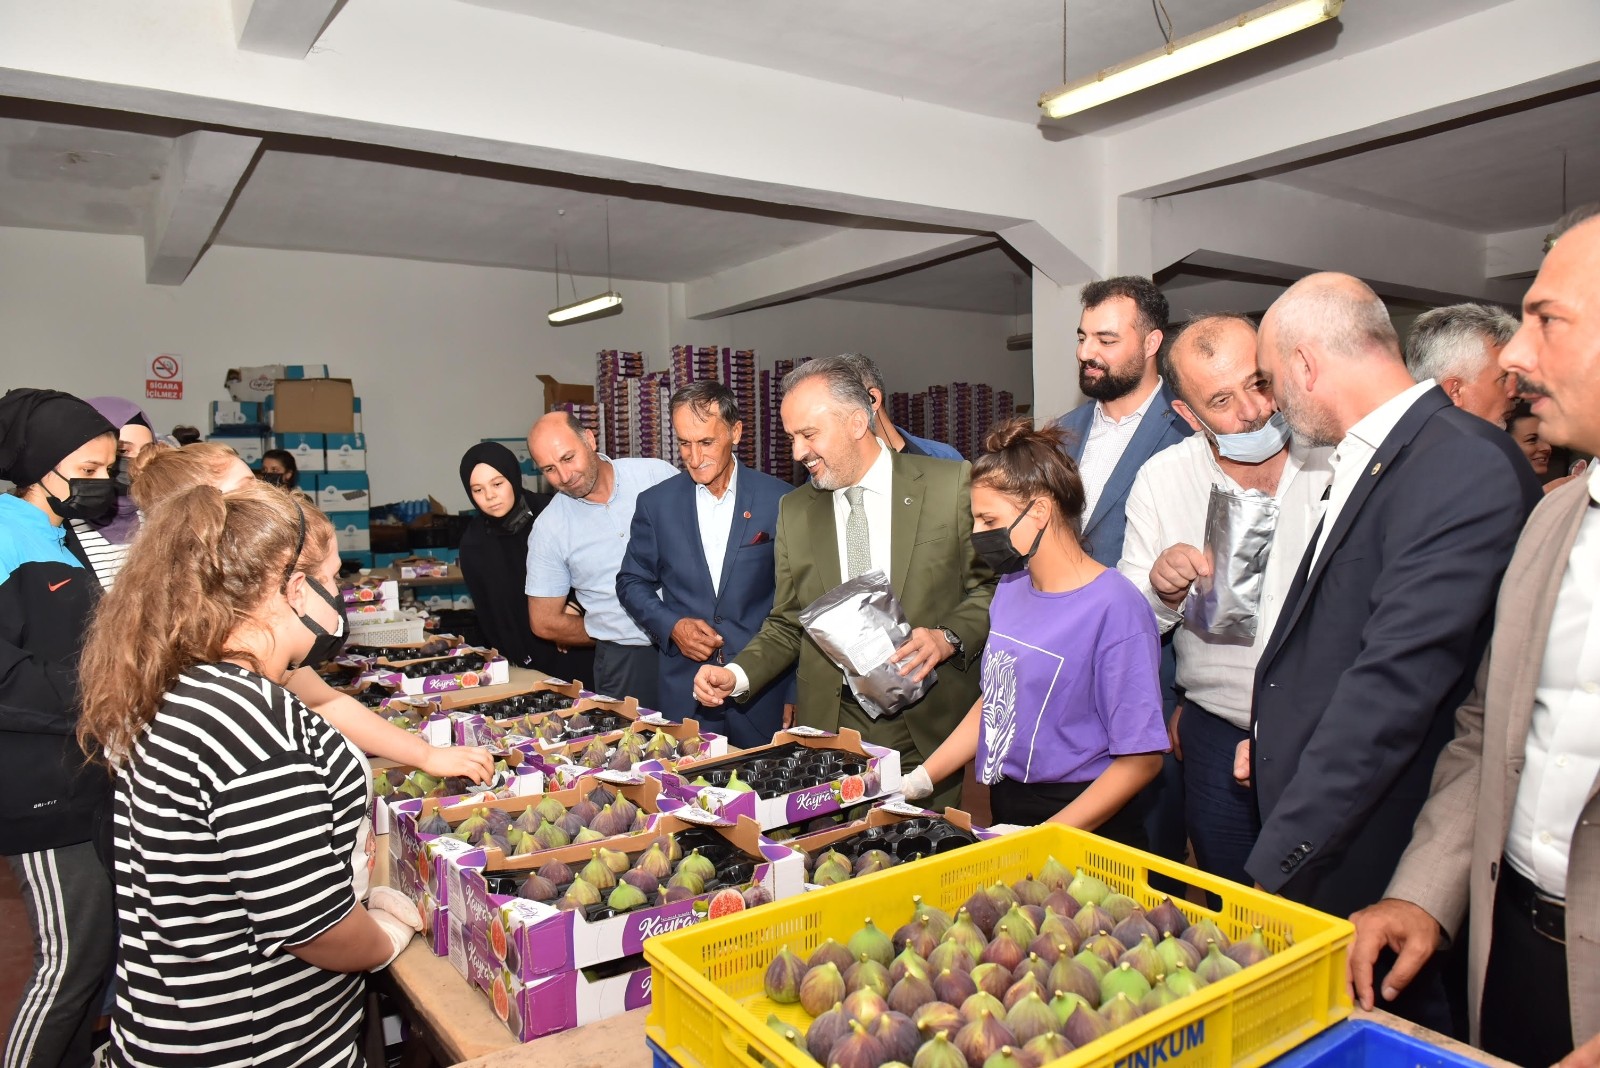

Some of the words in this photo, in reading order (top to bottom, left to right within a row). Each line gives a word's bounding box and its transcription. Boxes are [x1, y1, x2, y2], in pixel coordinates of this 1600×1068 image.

[149, 381, 179, 390] SİGARA
[430, 679, 455, 690] Kayra
[796, 792, 832, 811] Kayra
[466, 885, 490, 922] Kayra
[638, 915, 694, 941] Kayra
[468, 942, 491, 980] Kayra
